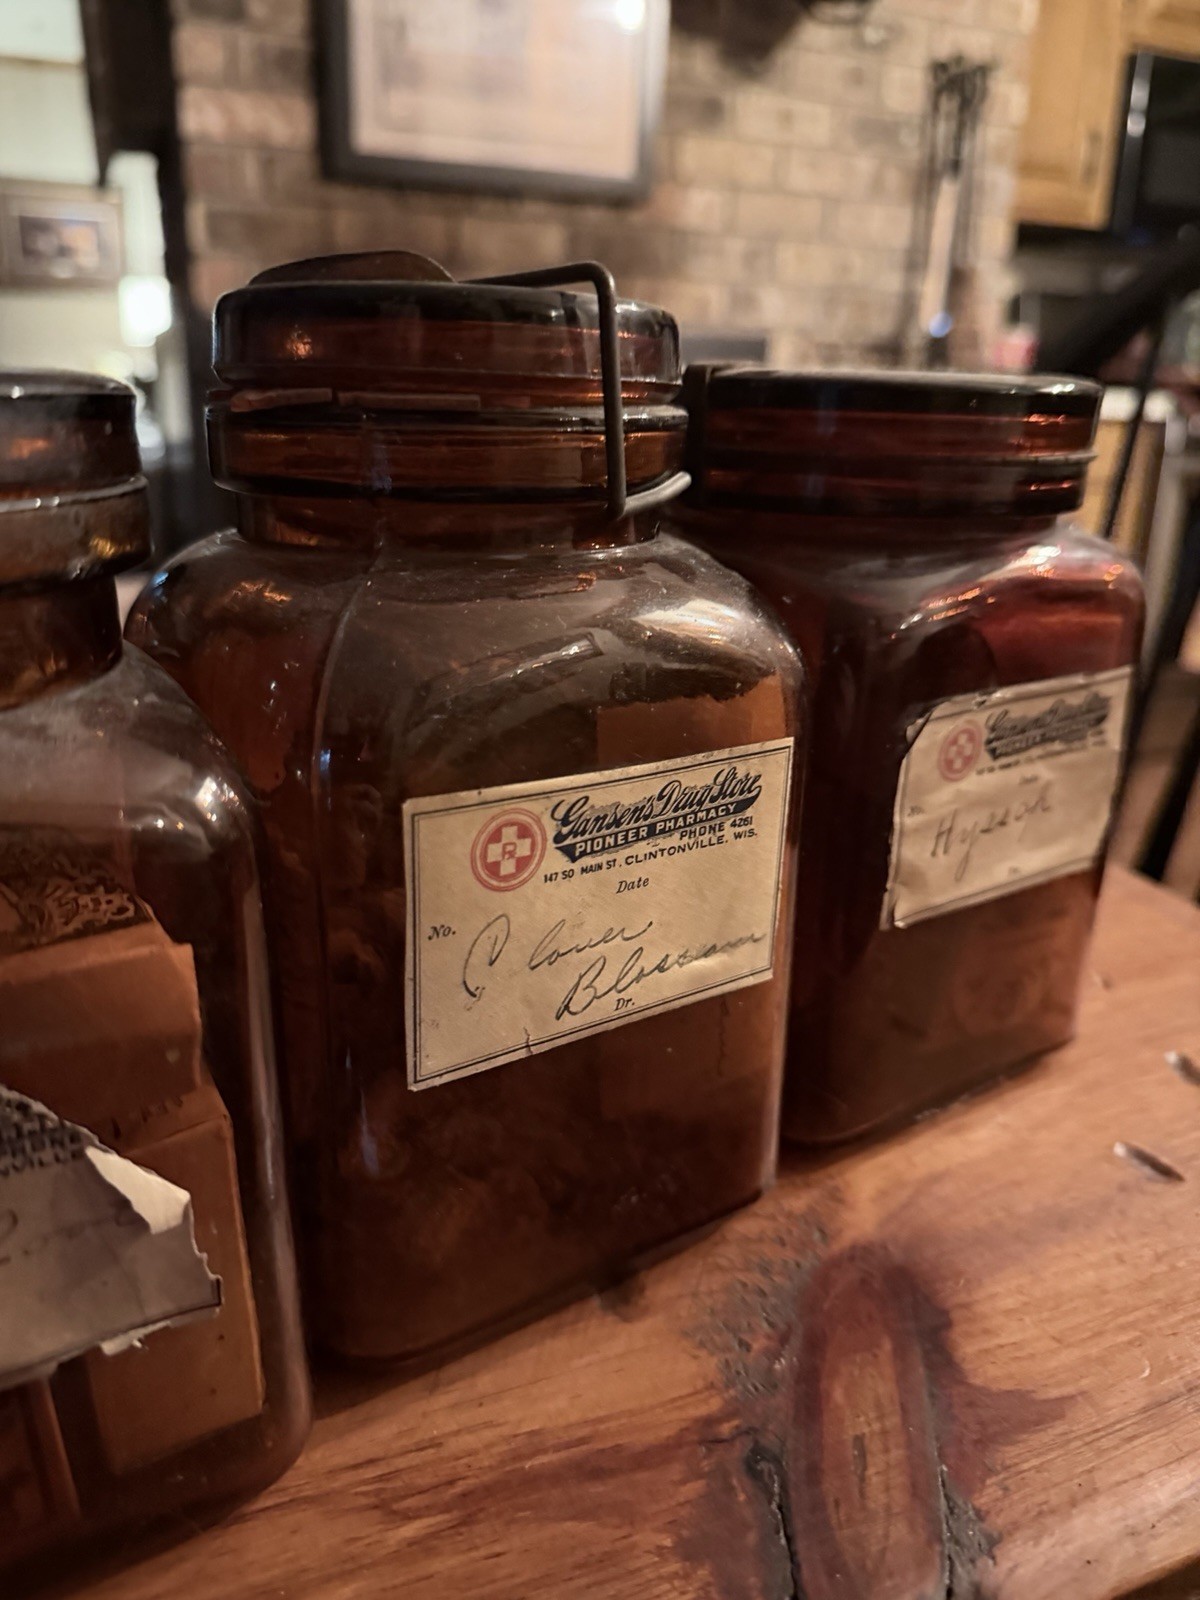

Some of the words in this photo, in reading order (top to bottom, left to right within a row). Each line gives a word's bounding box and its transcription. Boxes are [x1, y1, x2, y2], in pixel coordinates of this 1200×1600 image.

[650, 780, 715, 819] Drug
[709, 766, 762, 803] Store
[574, 826, 649, 857] PIONEER
[654, 802, 738, 835] PHARMACY
[680, 821, 726, 841] PHONE
[730, 815, 753, 828] 4261
[543, 872, 559, 884] 147
[561, 868, 575, 880] SO
[580, 862, 603, 875] MAIN
[733, 828, 758, 841] WIS.
[616, 876, 650, 895] Date
[427, 923, 457, 941] No.
[614, 997, 636, 1012] Dr.
